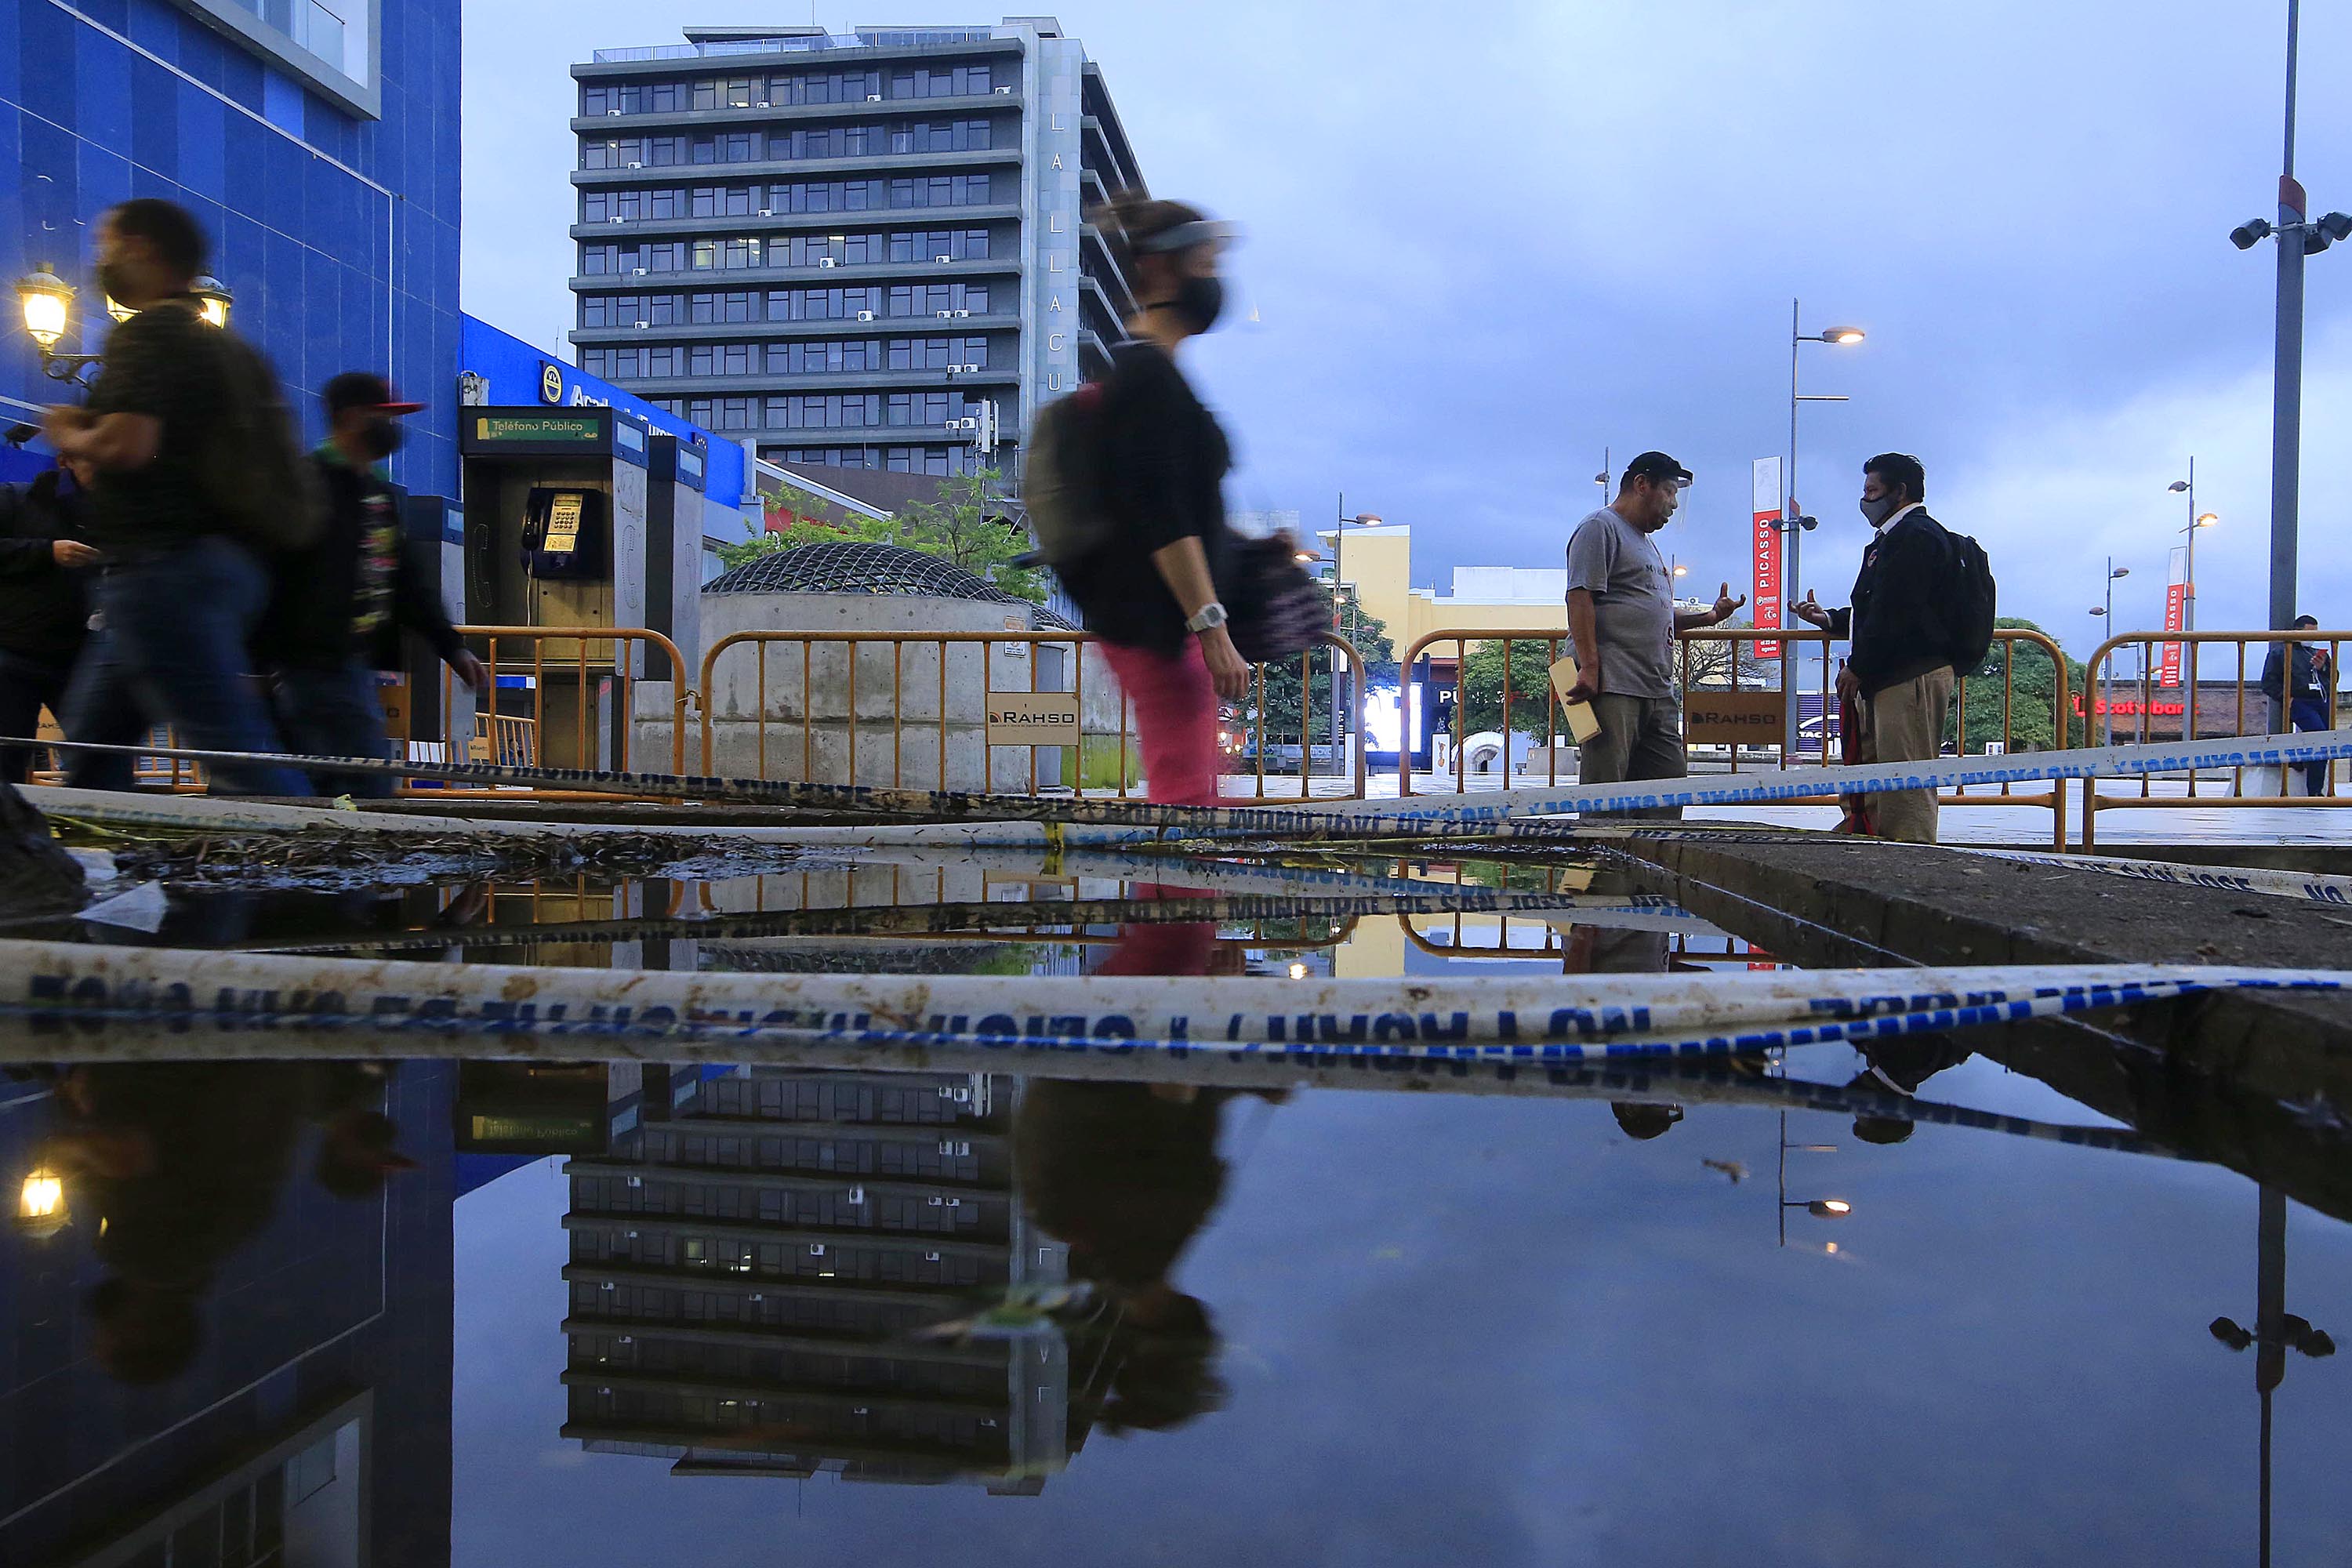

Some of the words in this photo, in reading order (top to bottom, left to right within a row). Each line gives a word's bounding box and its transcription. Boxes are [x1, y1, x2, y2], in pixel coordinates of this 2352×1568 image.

[1047, 214, 1065, 391] LLACU
[492, 420, 539, 431] Teléfono
[543, 420, 583, 431] Público
[1759, 518, 1770, 589] PICASSO
[2168, 590, 2177, 632] ICASSO
[1004, 711, 1075, 723] RAHSO
[1705, 712, 1777, 724] RAHSO
